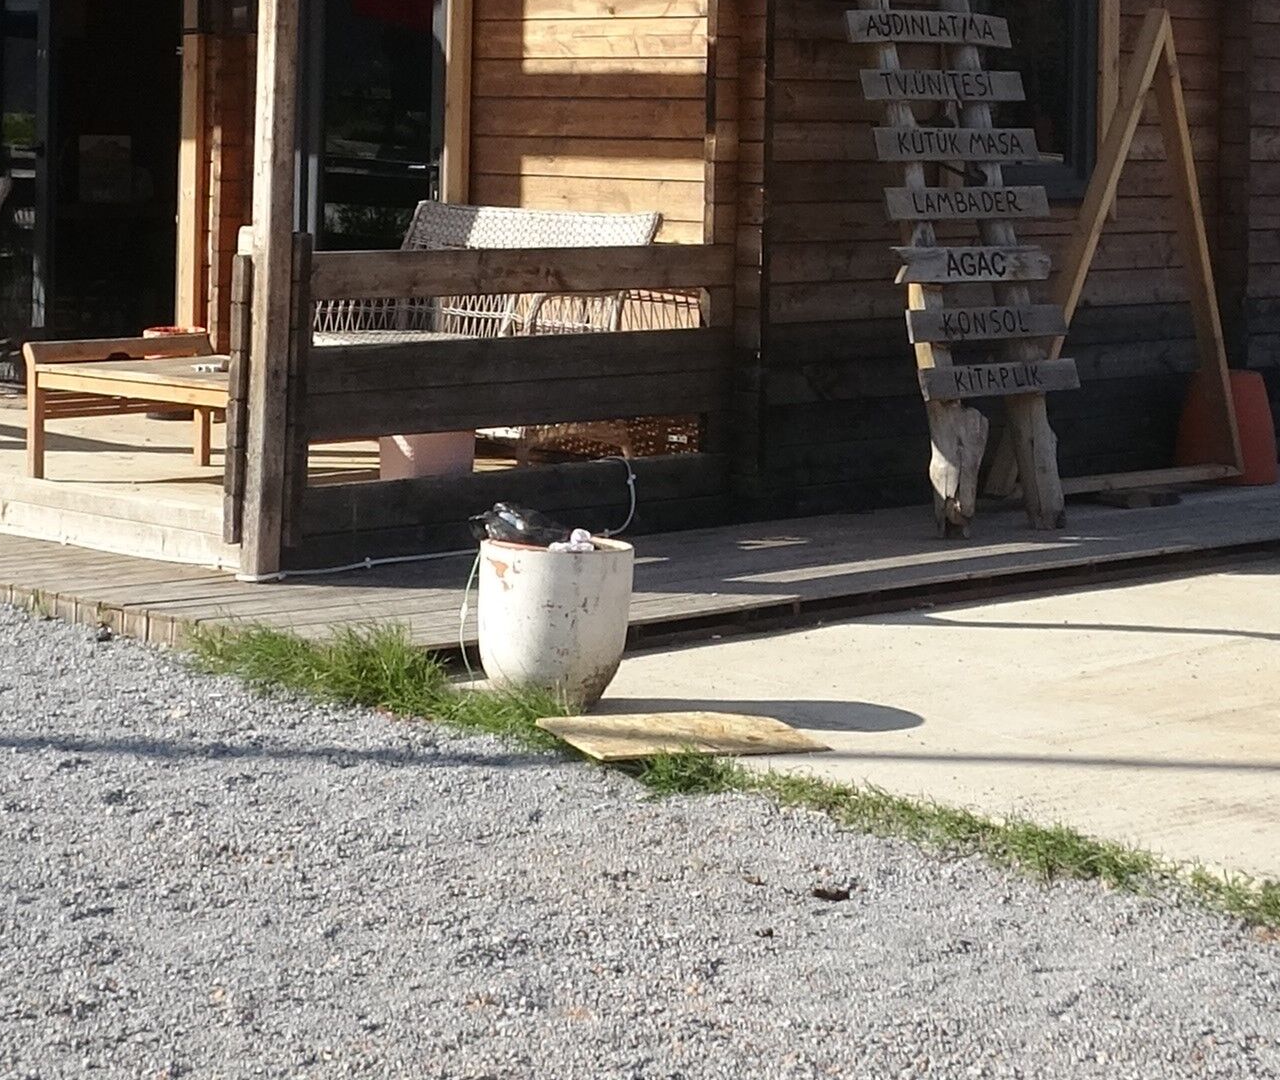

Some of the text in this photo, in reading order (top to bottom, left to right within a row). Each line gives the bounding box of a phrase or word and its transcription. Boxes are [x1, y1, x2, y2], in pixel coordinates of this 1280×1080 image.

[866, 13, 995, 41] AYDINLATMA
[897, 129, 1024, 154] KÜTÜK MASA
[912, 191, 1022, 214] LAMBADER
[941, 309, 1030, 335] KONSOL
[954, 366, 1043, 392] KİTAPLIK
